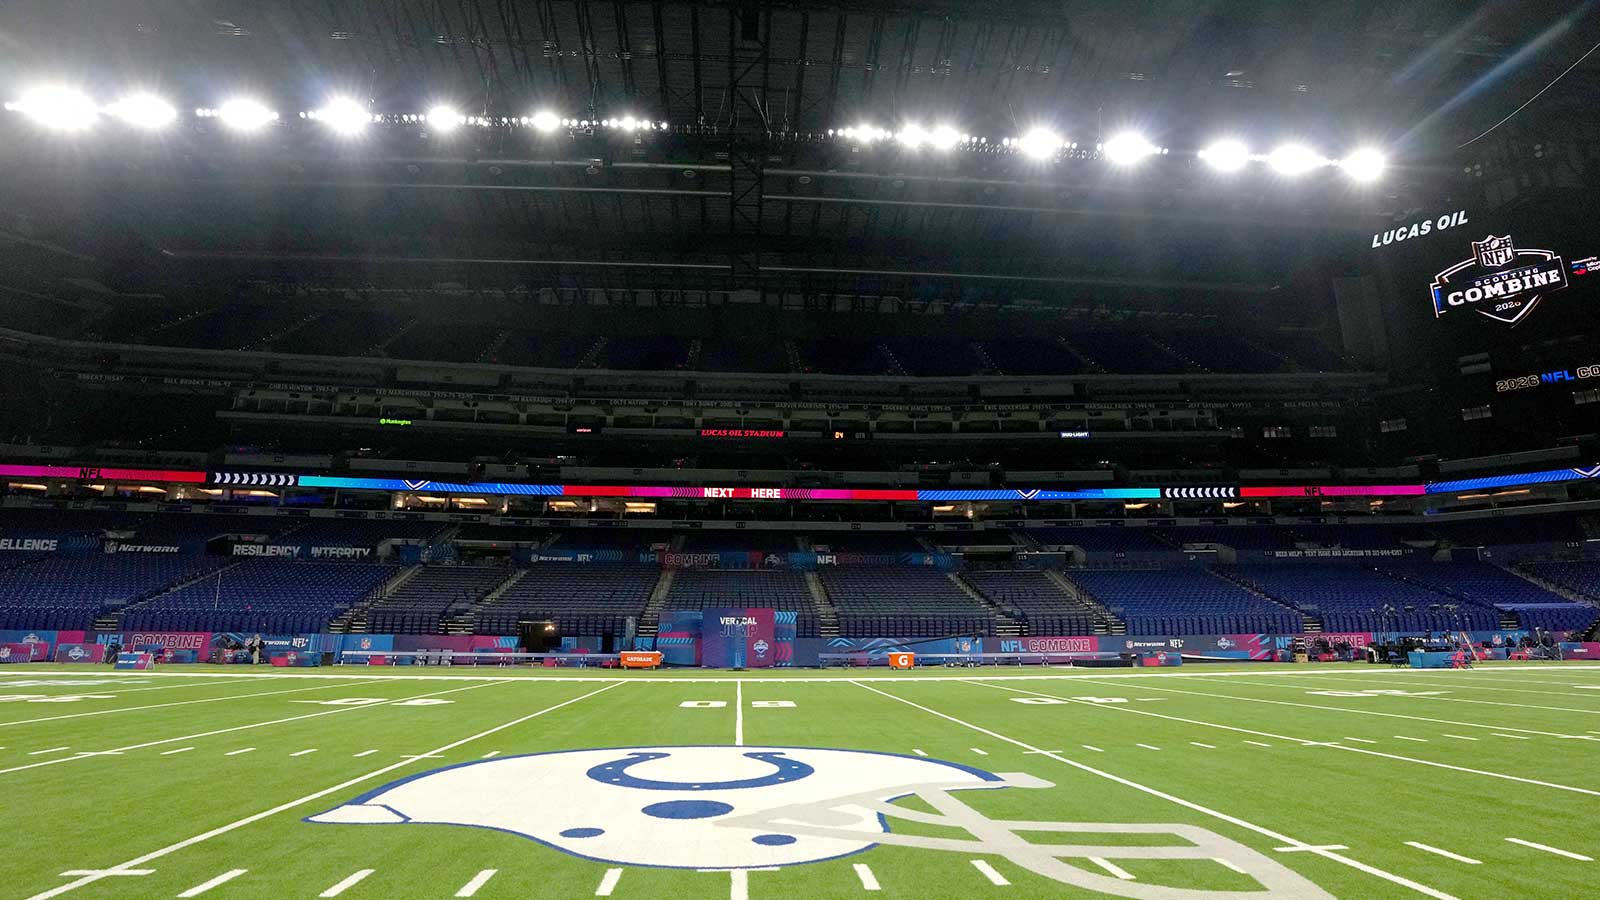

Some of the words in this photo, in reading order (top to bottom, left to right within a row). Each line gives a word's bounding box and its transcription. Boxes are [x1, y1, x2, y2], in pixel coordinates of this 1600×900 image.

[1370, 220, 1432, 248] LUCAS
[1437, 210, 1469, 230] OIL
[1481, 249, 1513, 267] NFL
[1475, 268, 1539, 286] SCOUTING
[1447, 270, 1561, 306] COMBINE
[1496, 375, 1540, 392] 2026
[1541, 370, 1575, 384] NFL
[701, 429, 728, 438] LUCAS
[728, 429, 743, 438] OIL
[743, 429, 784, 438] STADIUM
[79, 468, 103, 479] NFL
[704, 488, 735, 498] NEXT
[751, 488, 781, 498] HERE
[118, 544, 181, 553] NETWORK
[233, 544, 301, 557] RESILIENCY
[720, 617, 757, 625] VERCAL
[131, 634, 204, 649] COMBINE
[1001, 640, 1026, 653] NFL
[1028, 639, 1091, 652] COMBINE
[898, 655, 908, 666] G
